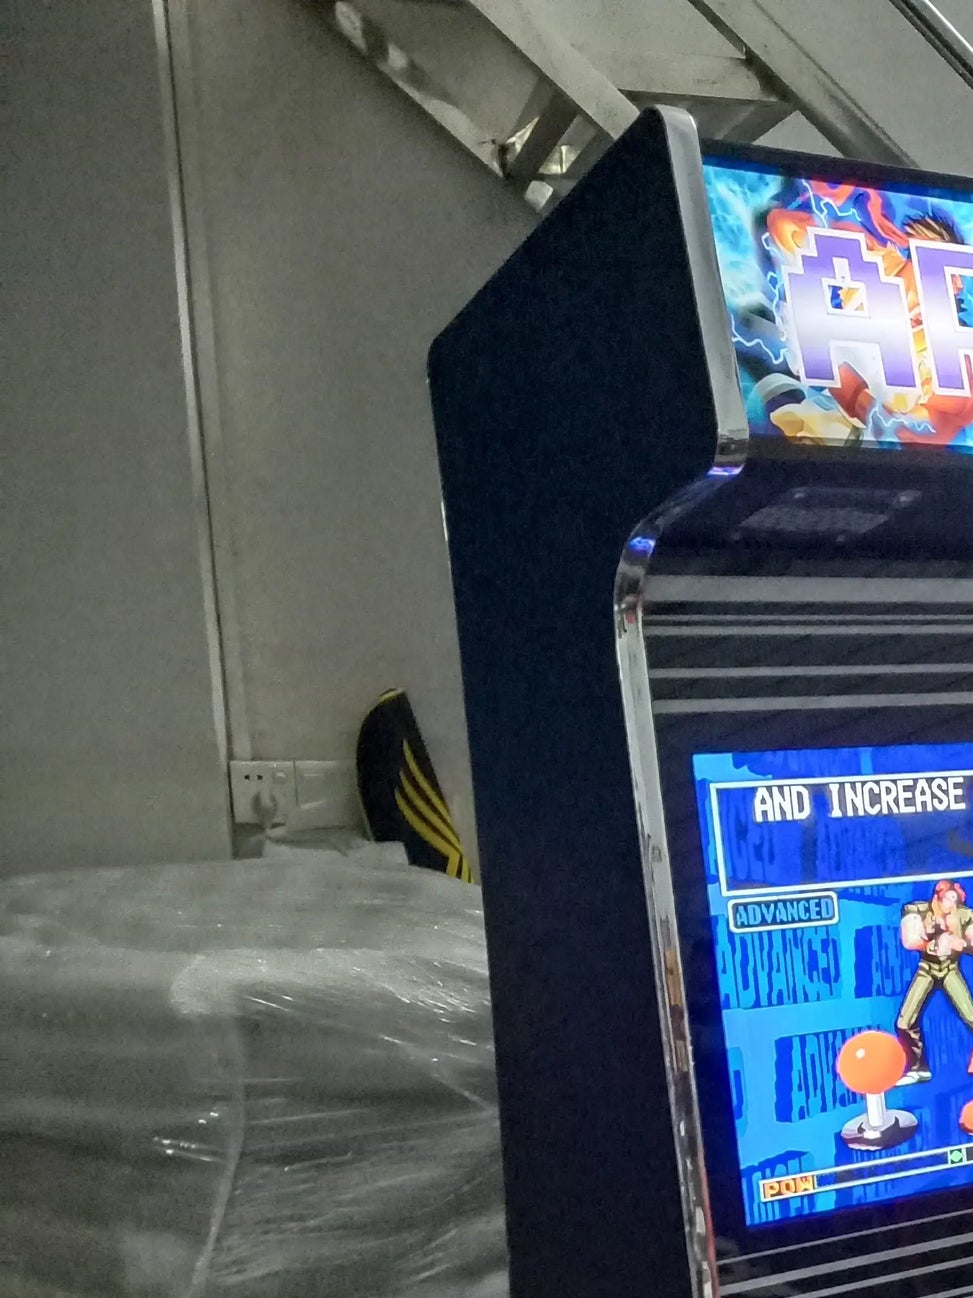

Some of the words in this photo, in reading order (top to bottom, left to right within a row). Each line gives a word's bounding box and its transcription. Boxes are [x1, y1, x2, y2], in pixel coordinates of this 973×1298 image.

[753, 785, 811, 822] AND
[829, 777, 966, 818] INCREASE
[735, 900, 834, 926] ADVANCED
[763, 1174, 815, 1199] POW
